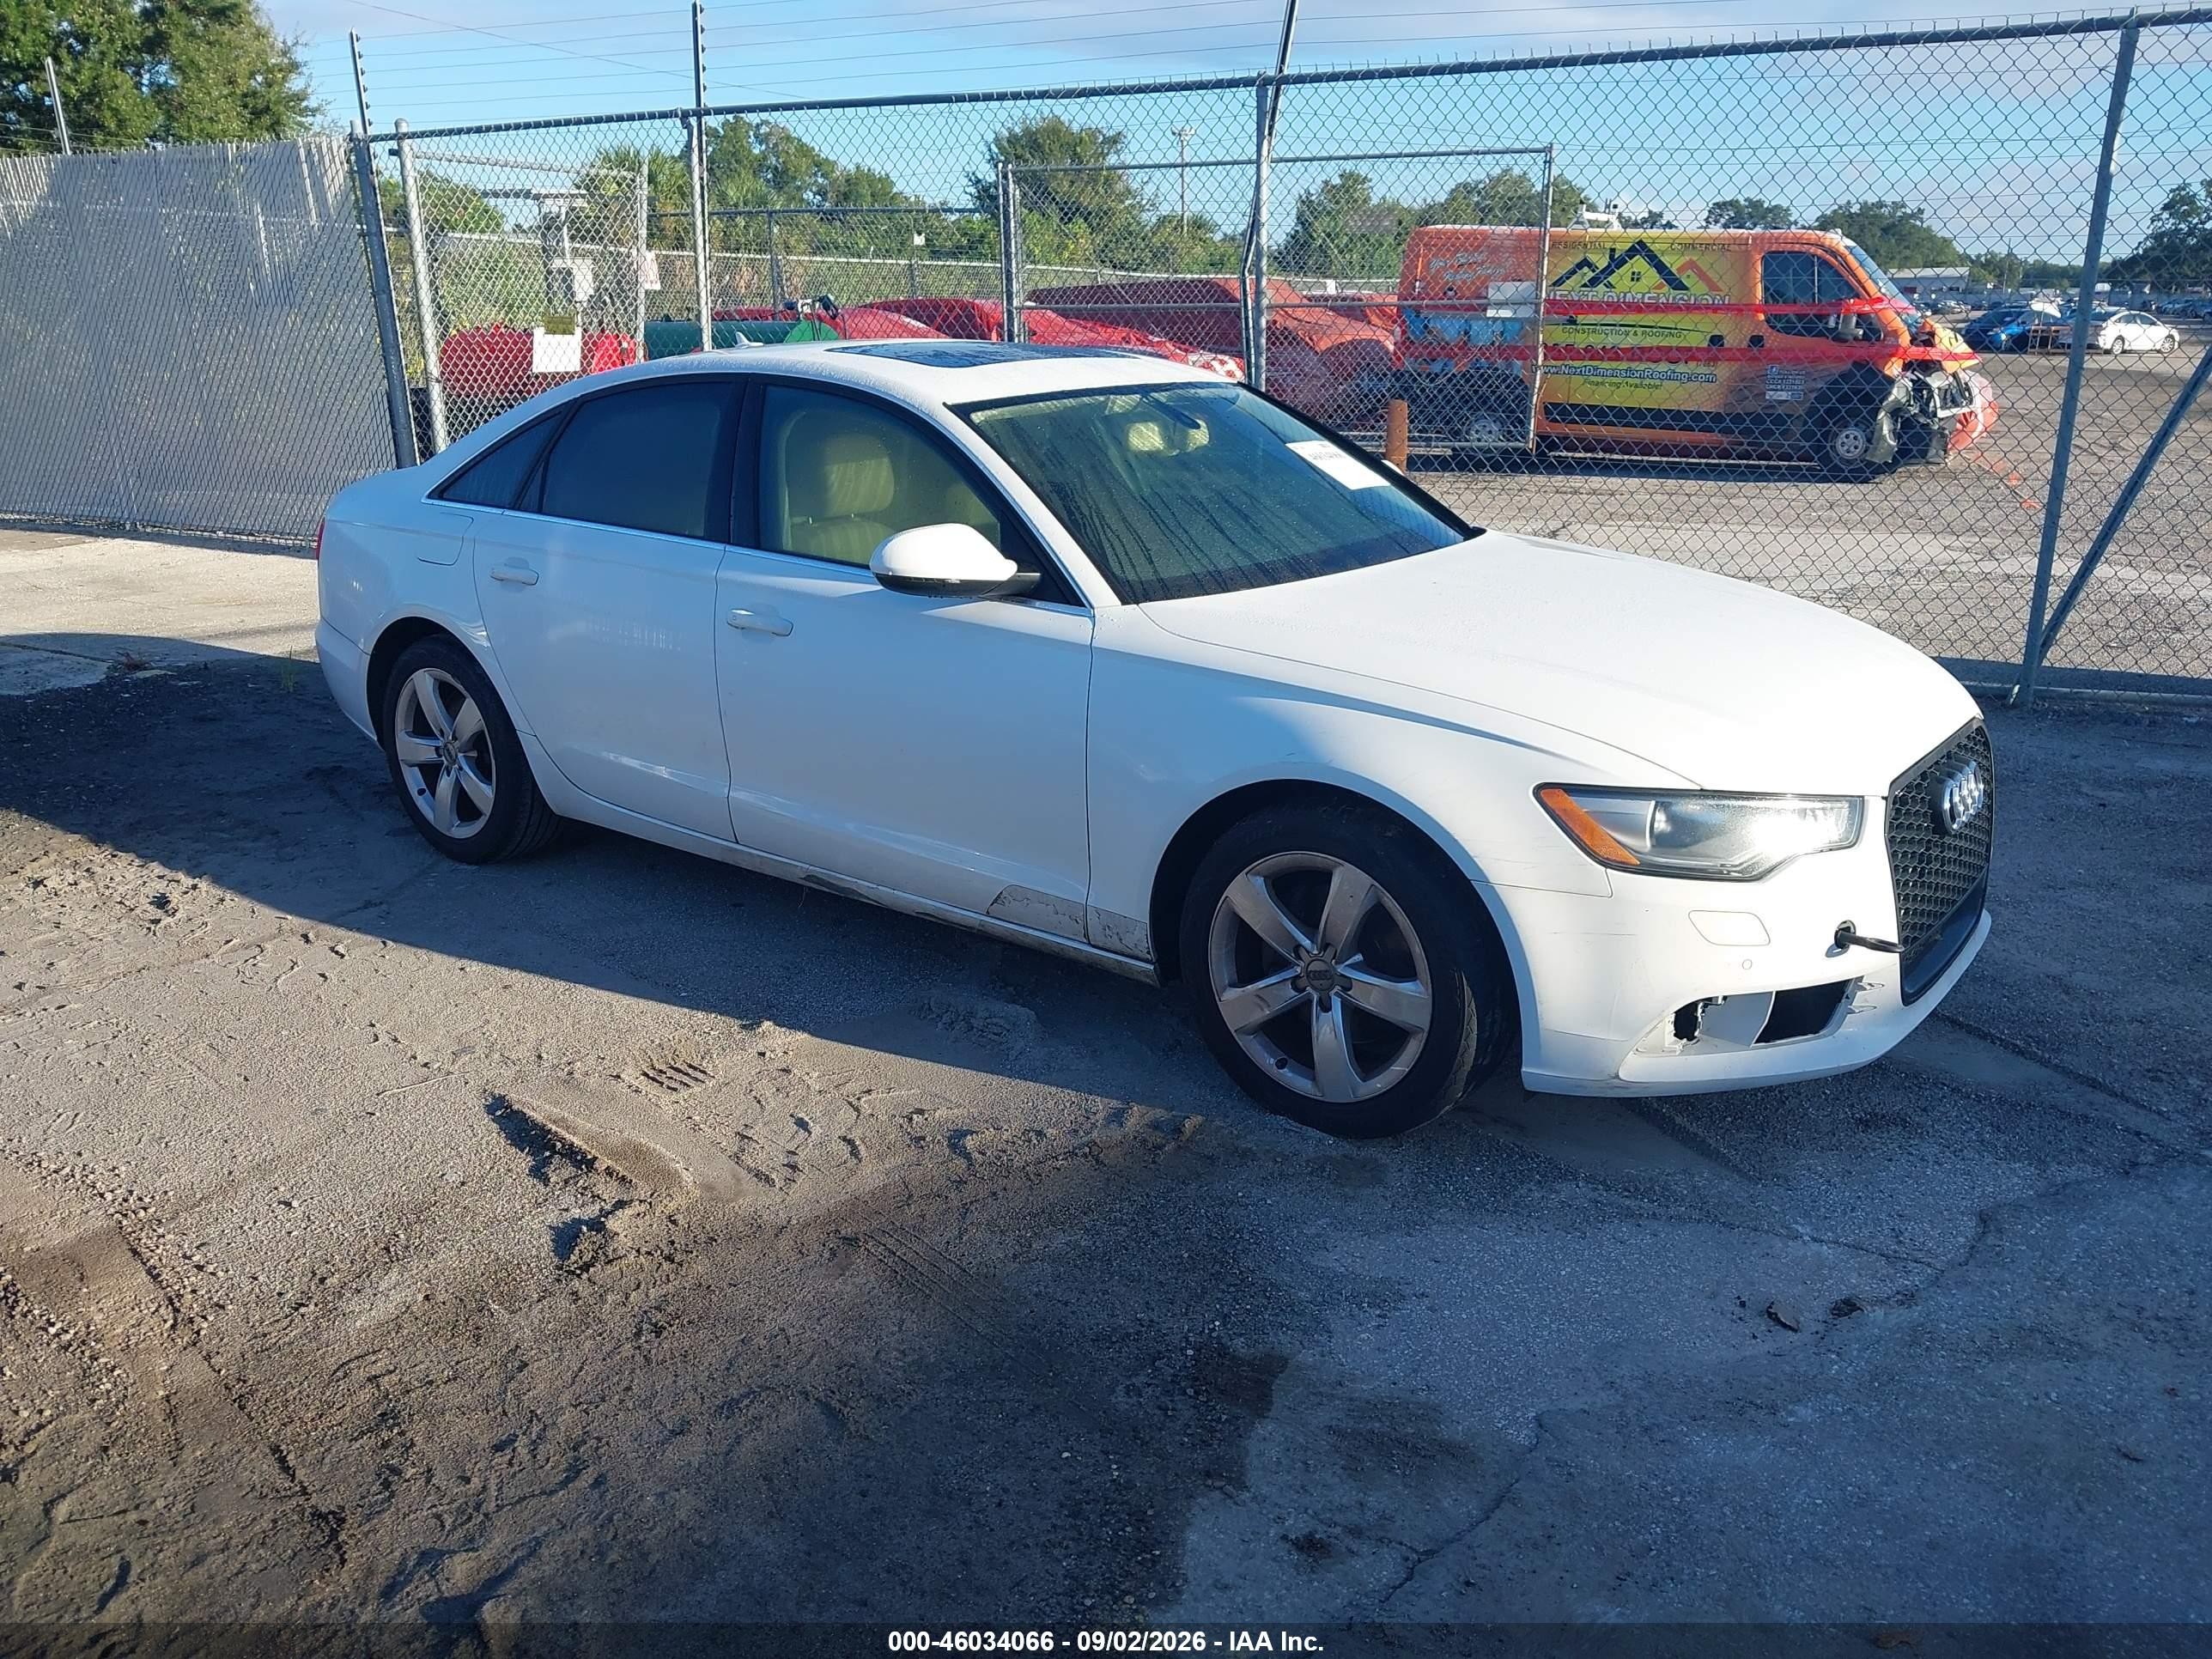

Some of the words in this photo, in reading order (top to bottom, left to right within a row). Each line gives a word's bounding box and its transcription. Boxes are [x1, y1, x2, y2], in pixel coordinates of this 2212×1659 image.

[1670, 242, 1732, 252] COMMERCIAL
[1561, 326, 1631, 337] CONSTRUCTION
[1641, 330, 1683, 339] ROOFING
